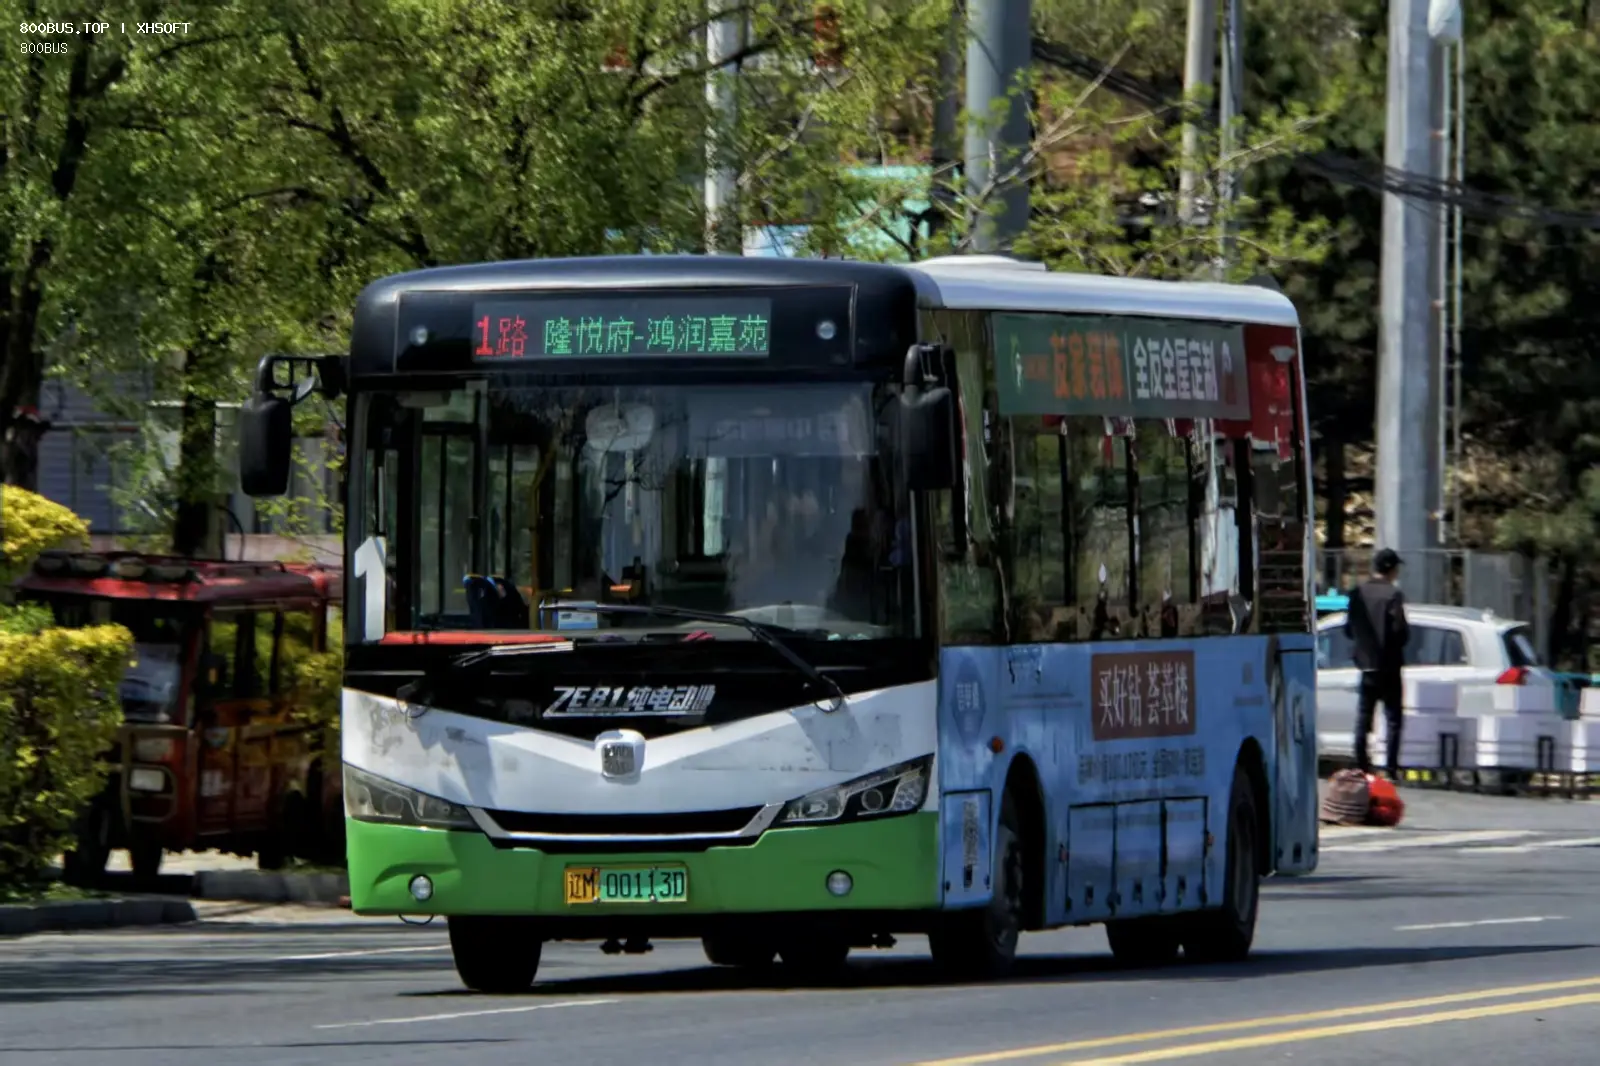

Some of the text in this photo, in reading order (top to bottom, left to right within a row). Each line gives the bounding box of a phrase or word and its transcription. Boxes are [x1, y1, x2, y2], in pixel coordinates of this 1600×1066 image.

[475, 314, 768, 358] 1路 隆悦府-鸿润嘉苑
[354, 536, 386, 641] 1
[605, 871, 685, 899] 00113D
